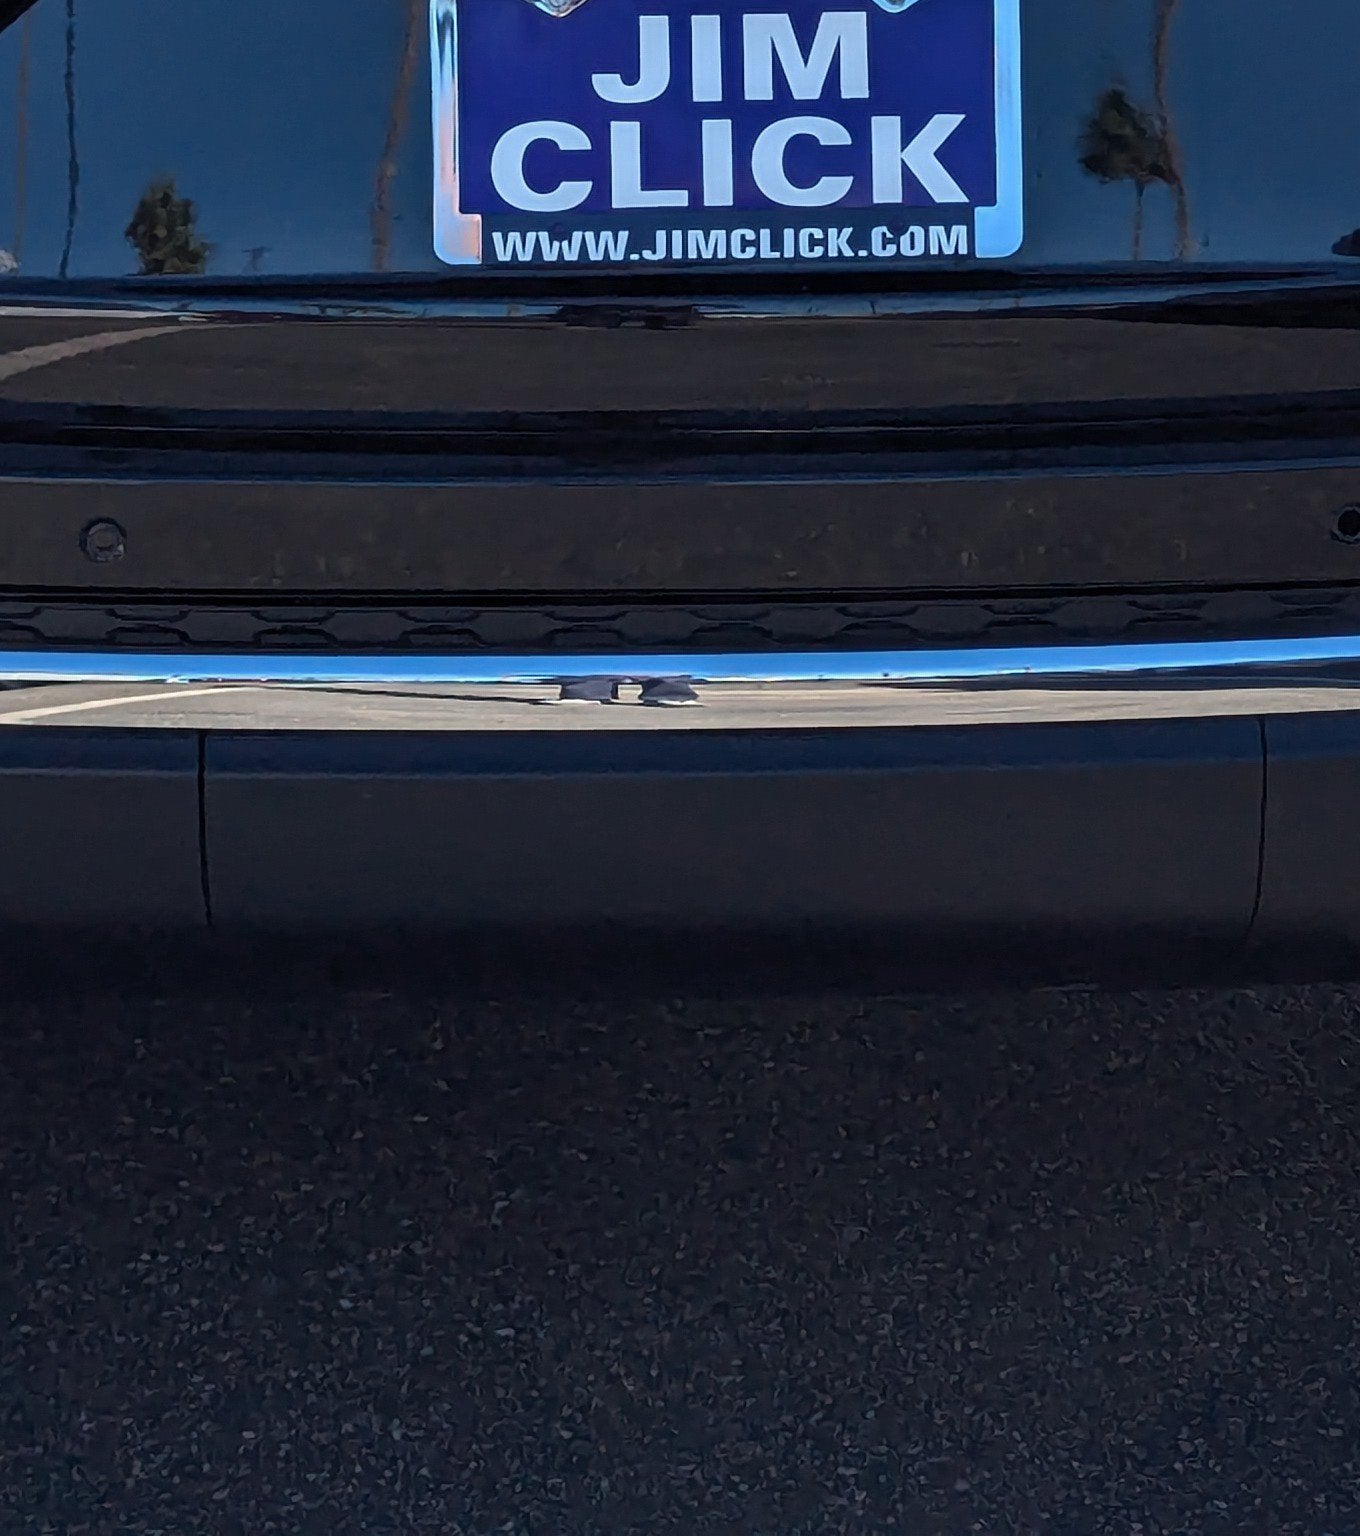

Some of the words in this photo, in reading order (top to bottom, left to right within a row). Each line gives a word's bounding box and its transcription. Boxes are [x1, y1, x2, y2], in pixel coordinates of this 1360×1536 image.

[591, 11, 870, 103] JIM
[491, 114, 970, 212] CLICK
[492, 225, 968, 262] WWW.JIMCLICK.COM
